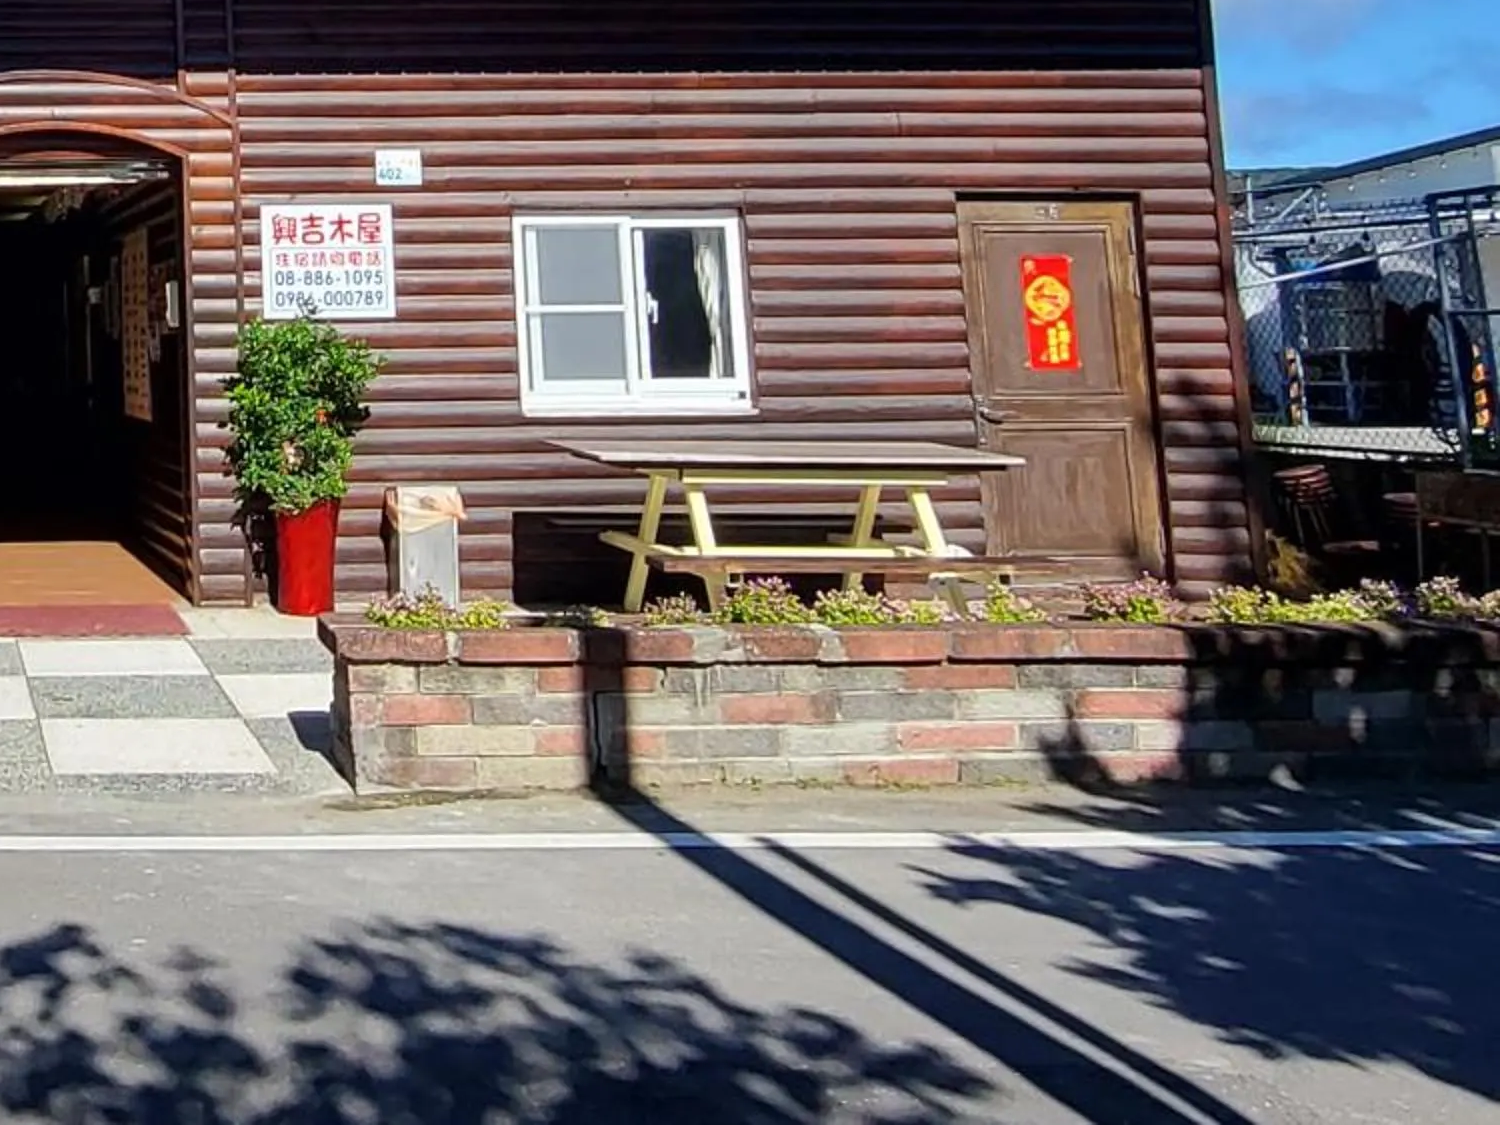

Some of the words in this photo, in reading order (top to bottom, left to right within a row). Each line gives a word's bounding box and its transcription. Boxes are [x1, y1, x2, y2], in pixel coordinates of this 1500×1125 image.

[271, 212, 382, 245] 興吉木屋
[275, 270, 383, 286] 08-886-1095
[275, 290, 384, 307] 0986-000789
